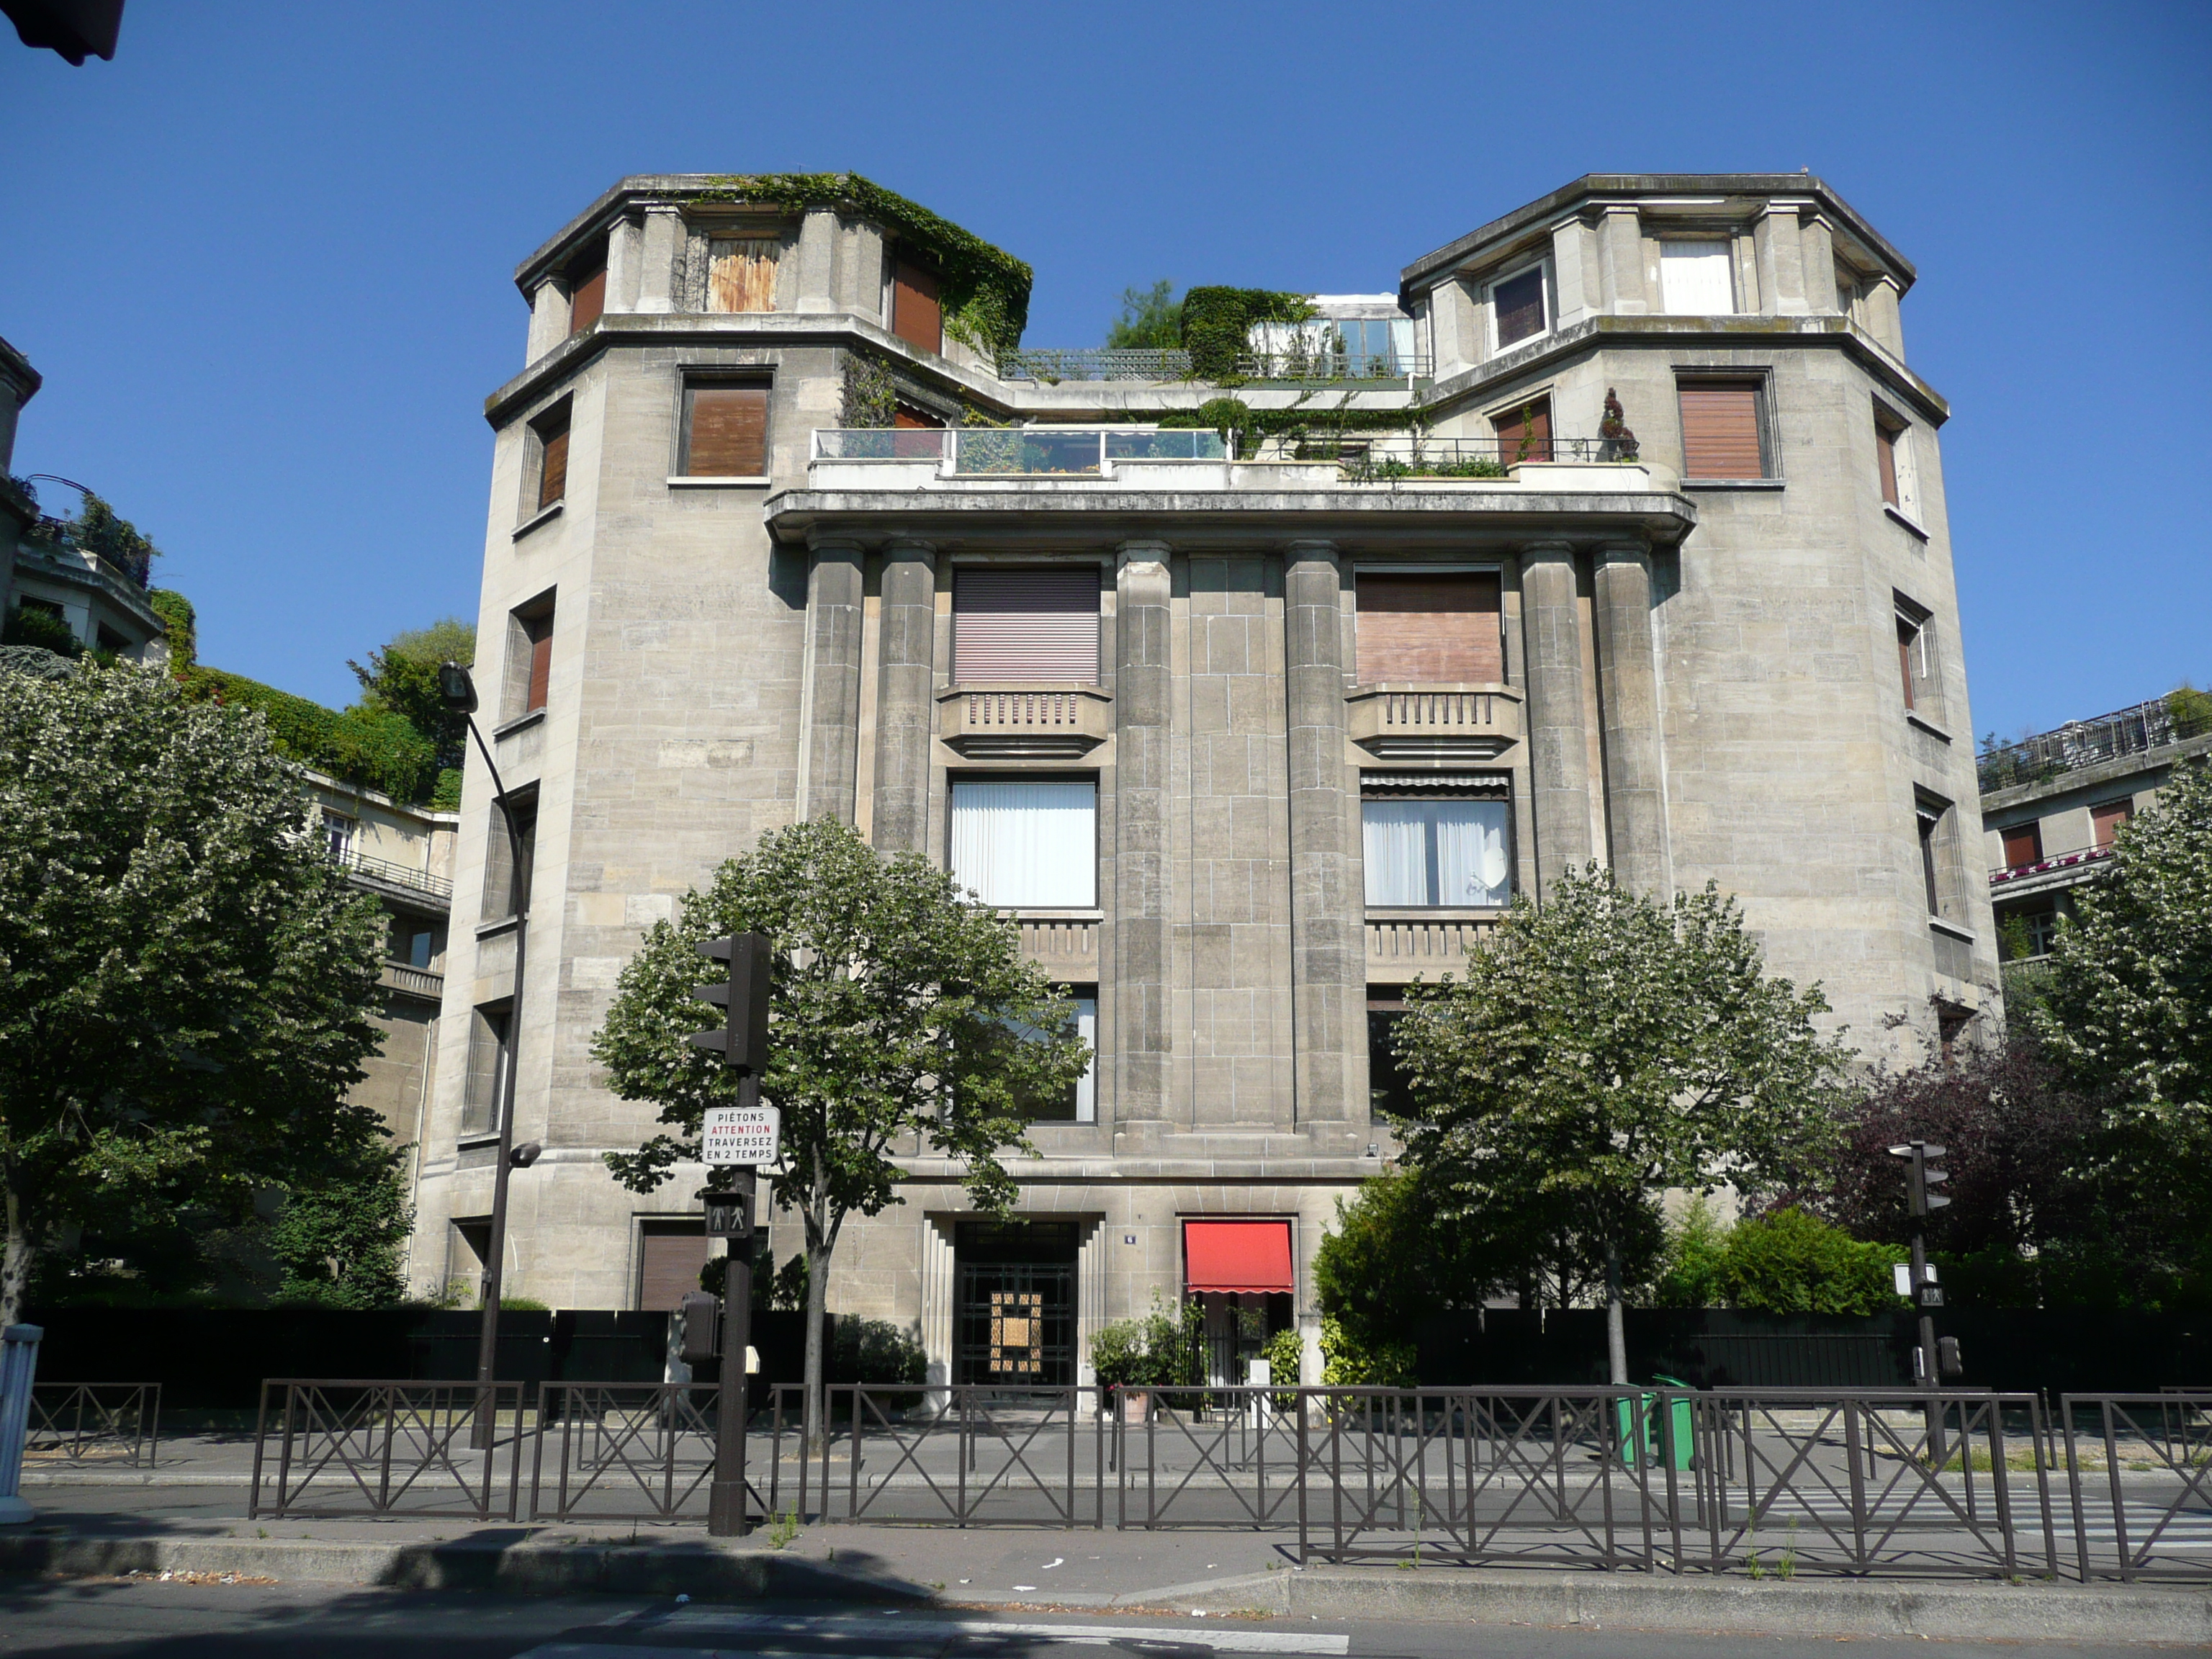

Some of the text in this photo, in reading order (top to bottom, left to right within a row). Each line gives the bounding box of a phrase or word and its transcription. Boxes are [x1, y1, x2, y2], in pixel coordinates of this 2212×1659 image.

[718, 1112, 764, 1122] PIÉTONS
[711, 1125, 770, 1135] ATTENTION
[709, 1137, 772, 1146] TRAVERSEZ
[707, 1149, 772, 1159] EN 2 TEMPS
